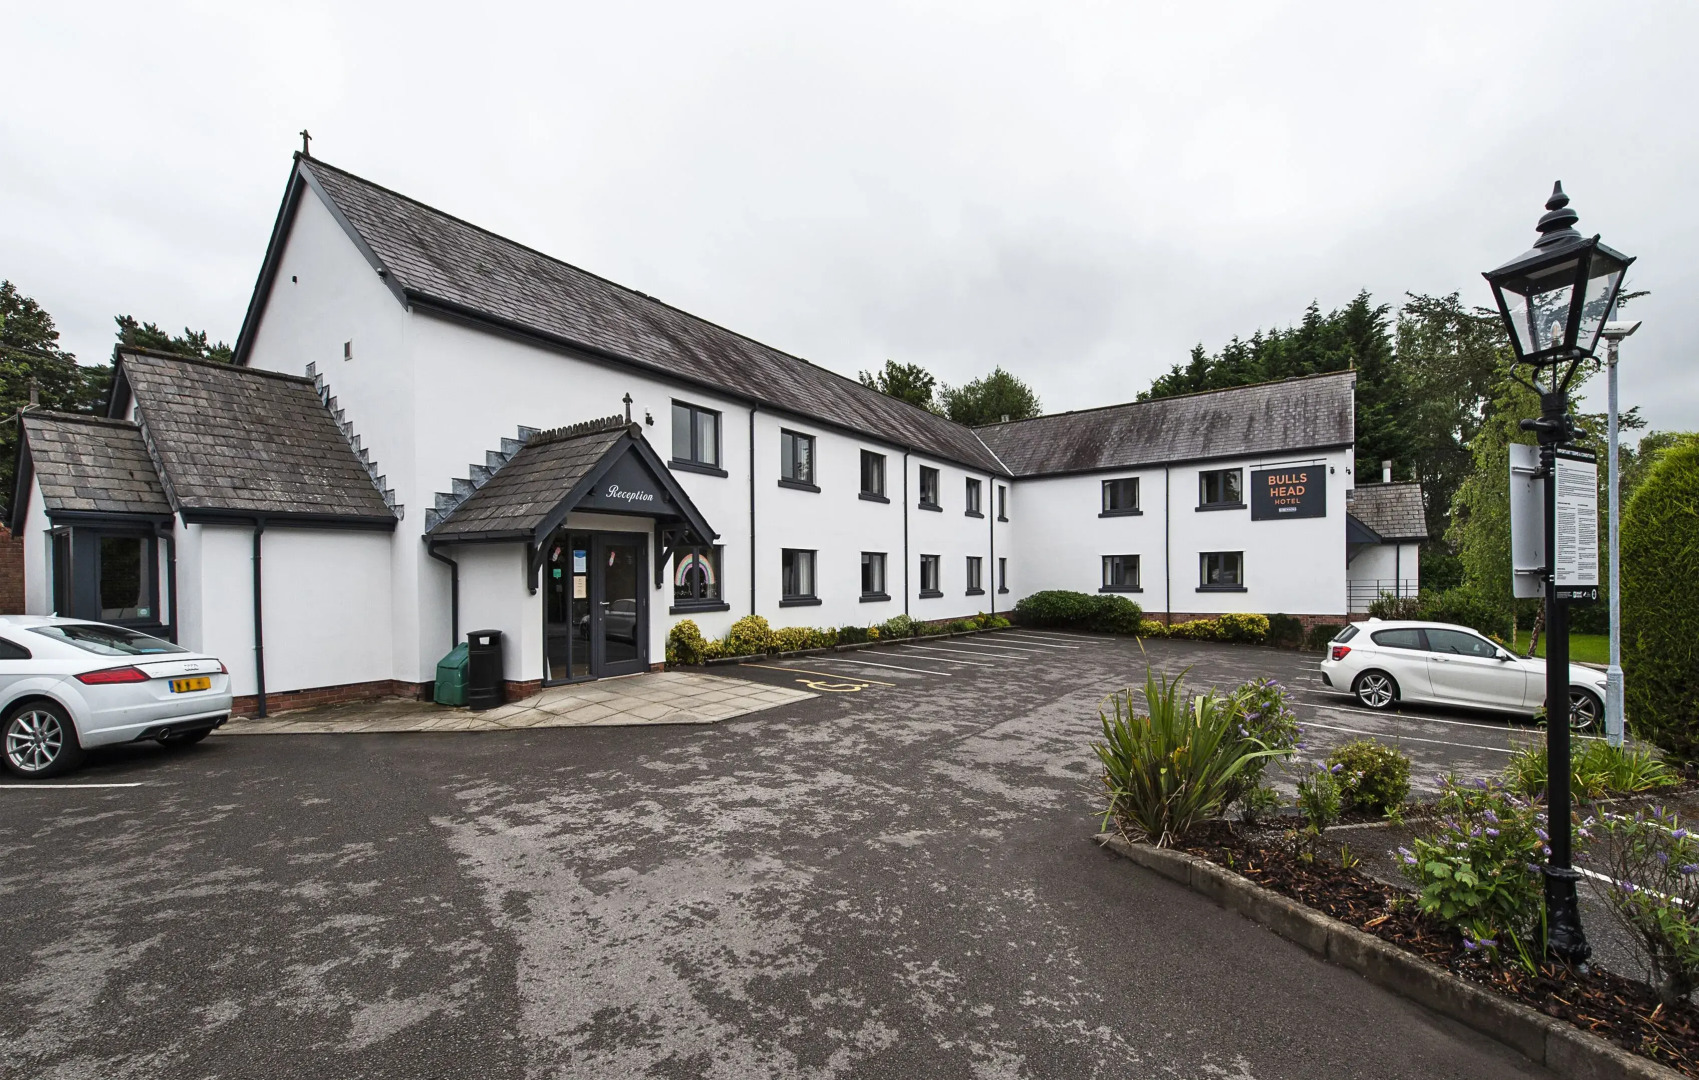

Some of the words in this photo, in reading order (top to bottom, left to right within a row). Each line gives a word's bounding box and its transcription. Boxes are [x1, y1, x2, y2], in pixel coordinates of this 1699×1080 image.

[1268, 473, 1308, 485] BULLS
[605, 484, 654, 503] Reception
[1270, 485, 1305, 497] HEAD
